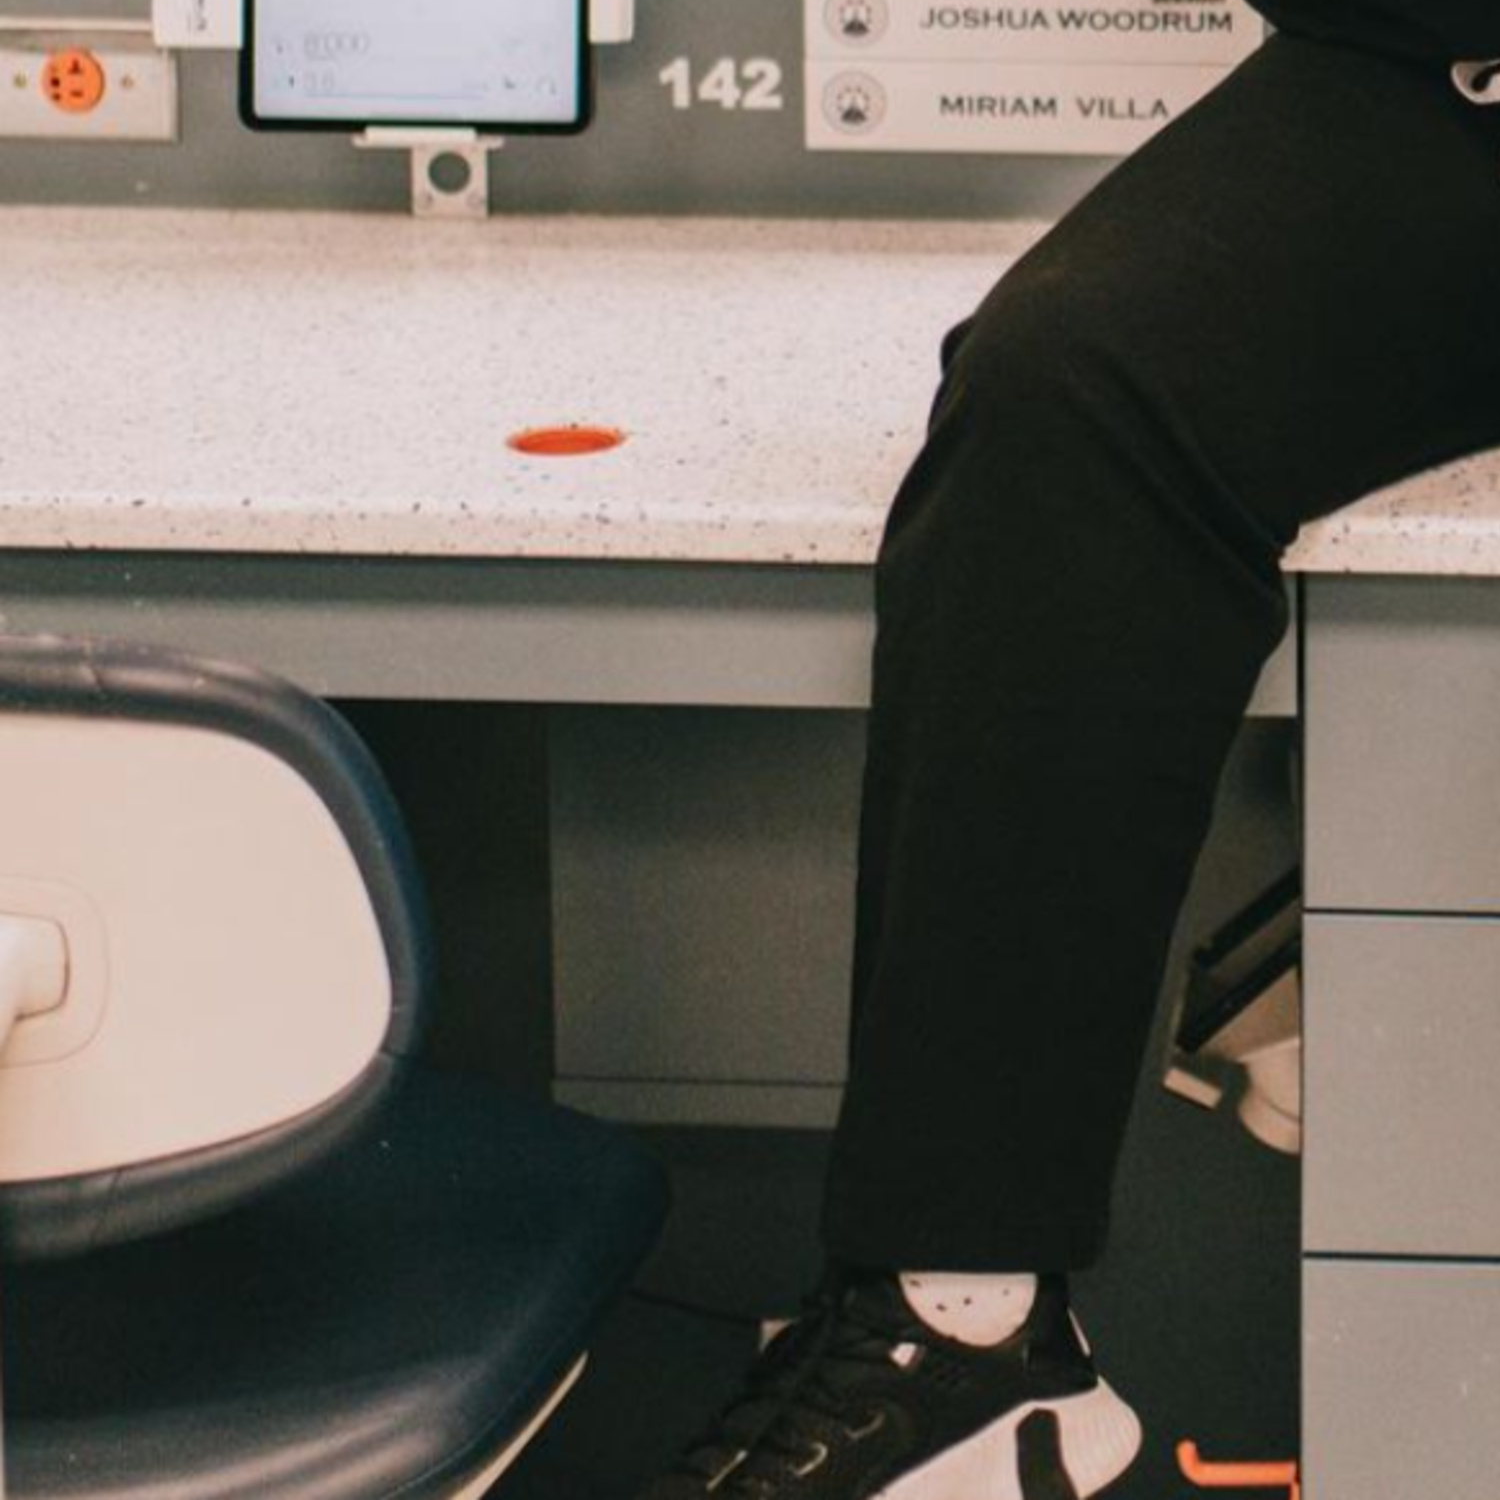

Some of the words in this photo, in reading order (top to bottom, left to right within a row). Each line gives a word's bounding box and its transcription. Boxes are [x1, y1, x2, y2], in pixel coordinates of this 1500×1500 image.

[919, 7, 1052, 31] JOSHUA
[1058, 9, 1234, 34] WOODRUM
[658, 56, 784, 111] 142
[940, 96, 1058, 118] MIRIAM
[1077, 97, 1169, 119] VILLA
